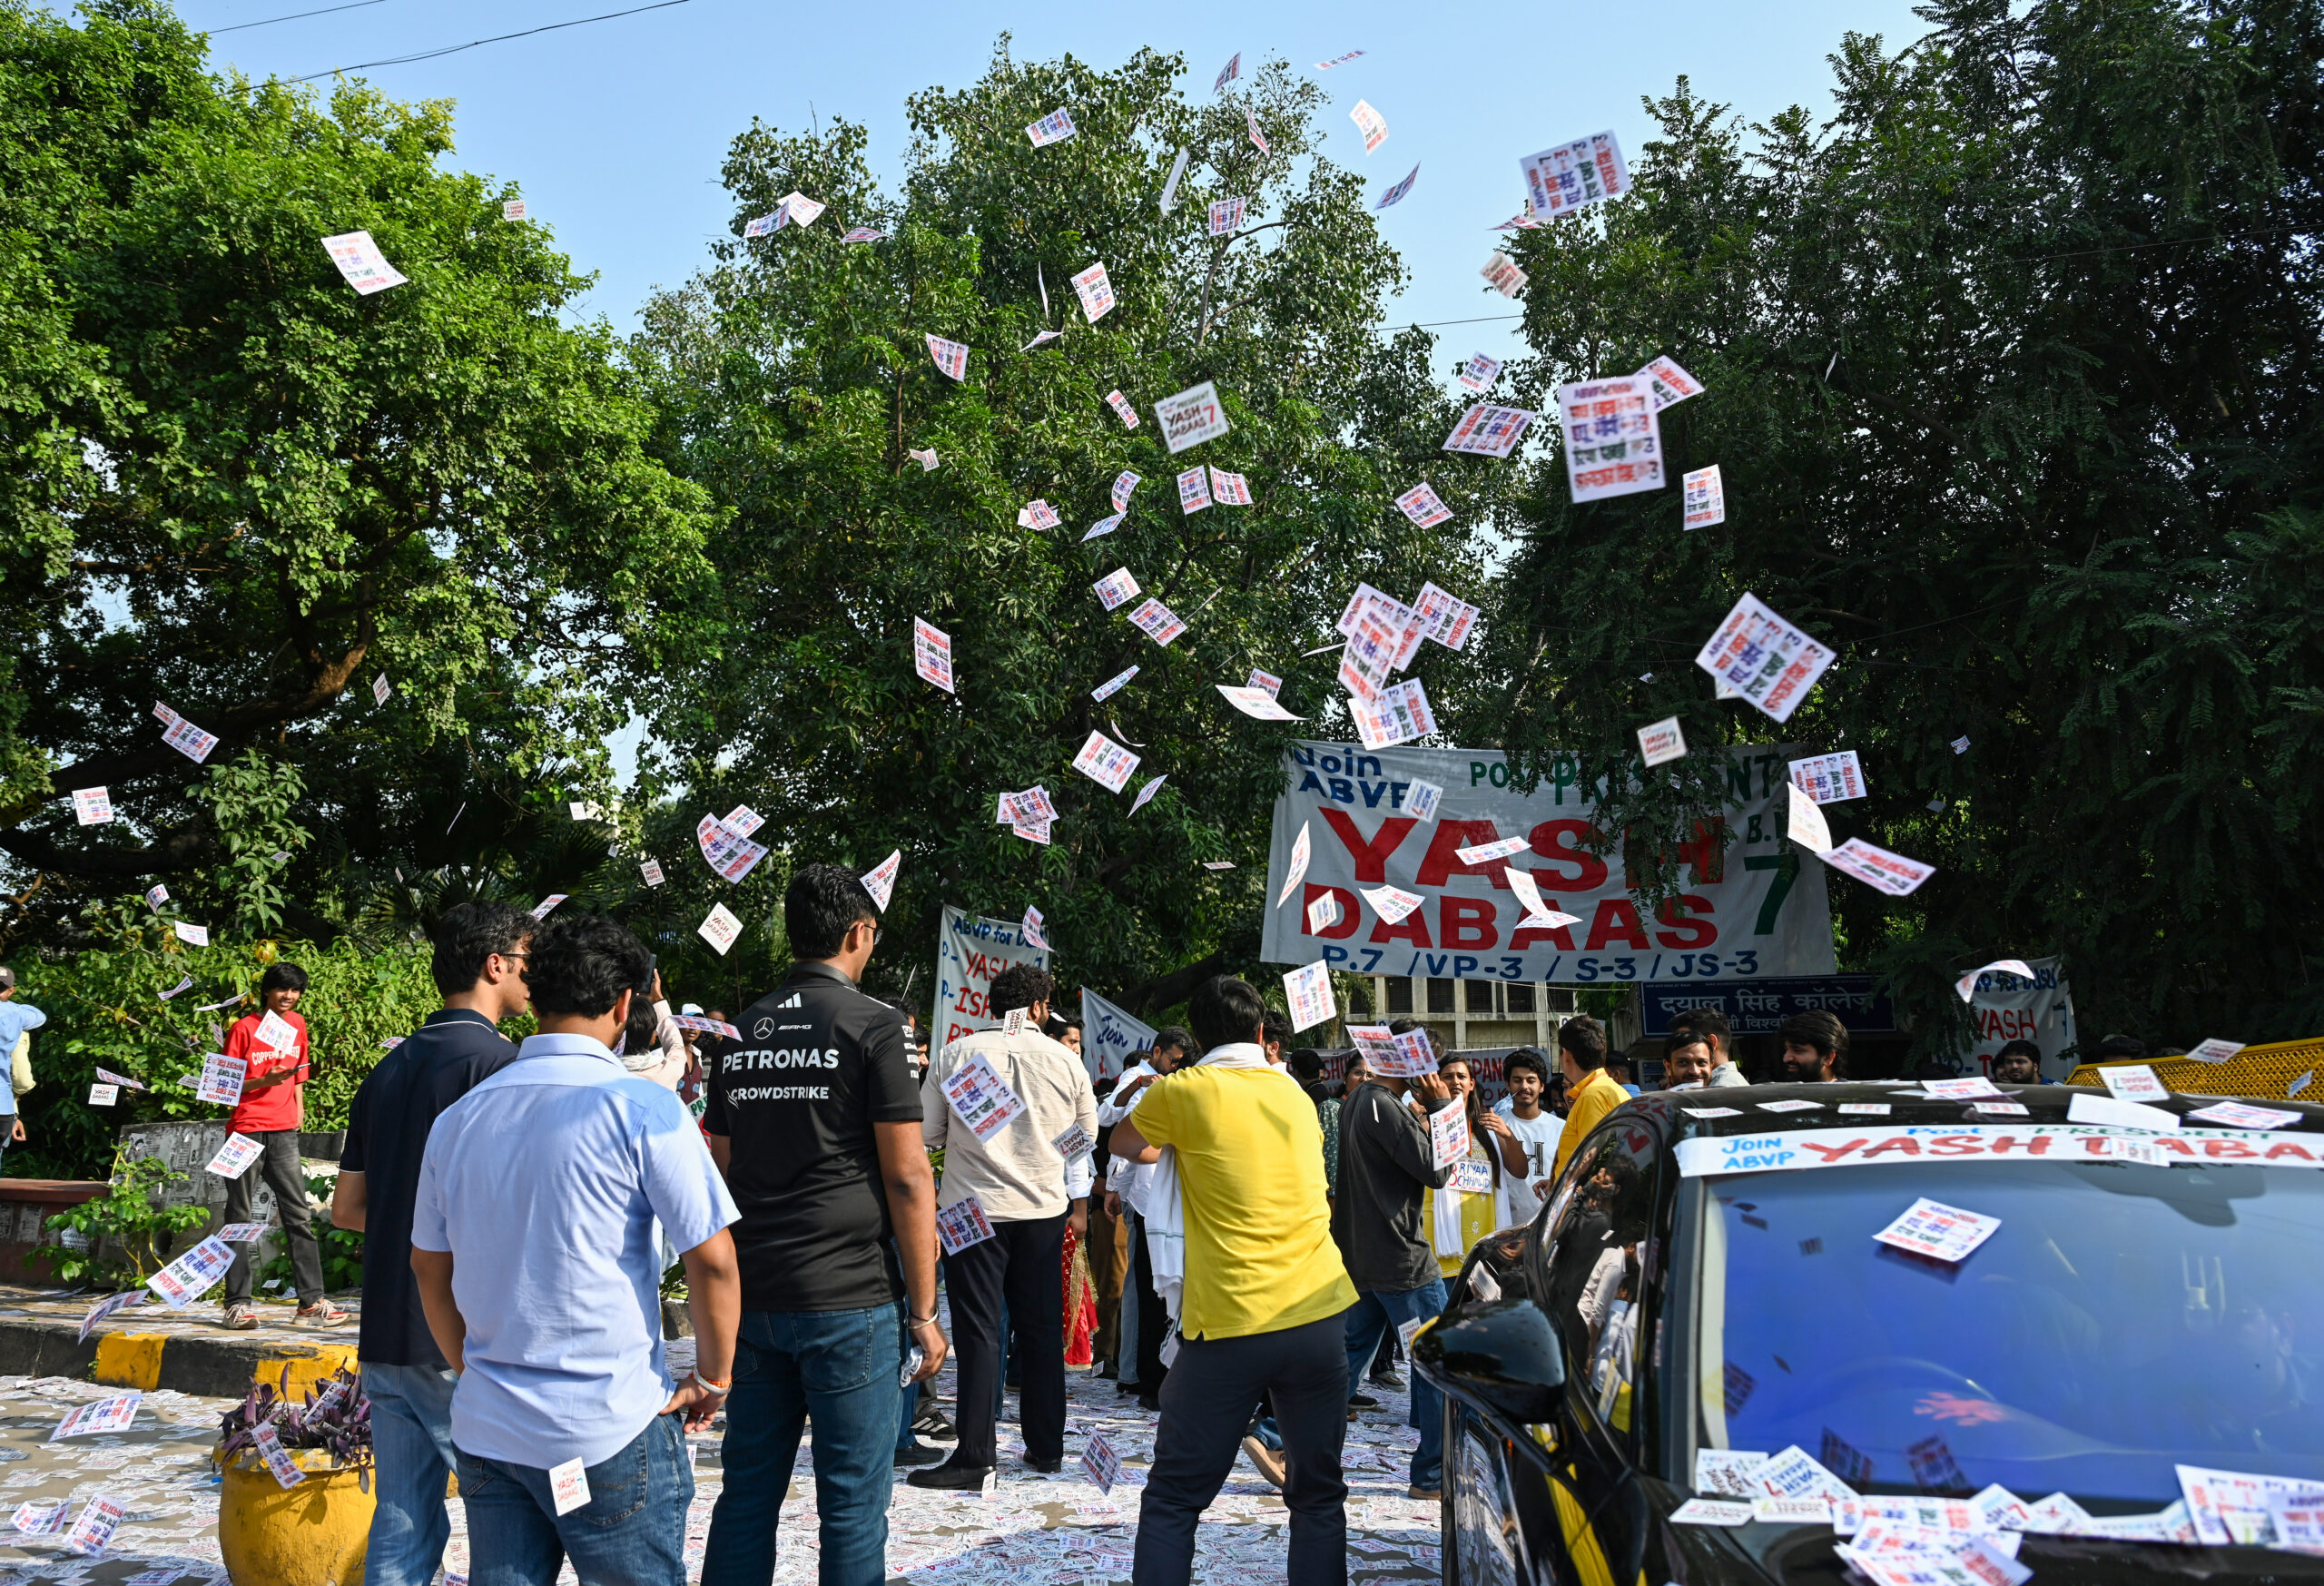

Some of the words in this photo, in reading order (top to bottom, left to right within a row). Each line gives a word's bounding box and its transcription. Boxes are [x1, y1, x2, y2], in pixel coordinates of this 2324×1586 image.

[1165, 404, 1200, 427] YASH
[1293, 746, 1382, 778] Join
[1318, 806, 1725, 892] YASH
[1745, 855, 1800, 935] 7
[953, 916, 991, 941] ABVP
[1301, 882, 1718, 951] DABAAS
[1670, 950, 1760, 978] JS-3
[1736, 989, 1783, 1011] सिंह
[1097, 1015, 1128, 1048] Join
[723, 1049, 839, 1074] PETRONAS
[731, 1087, 829, 1100] CROWDSTRIKE
[1721, 1137, 1782, 1154] JOIN
[1800, 1135, 2053, 1163] YASH
[1459, 1163, 1488, 1176] RIYAA
[1723, 1151, 1795, 1169] ABVP
